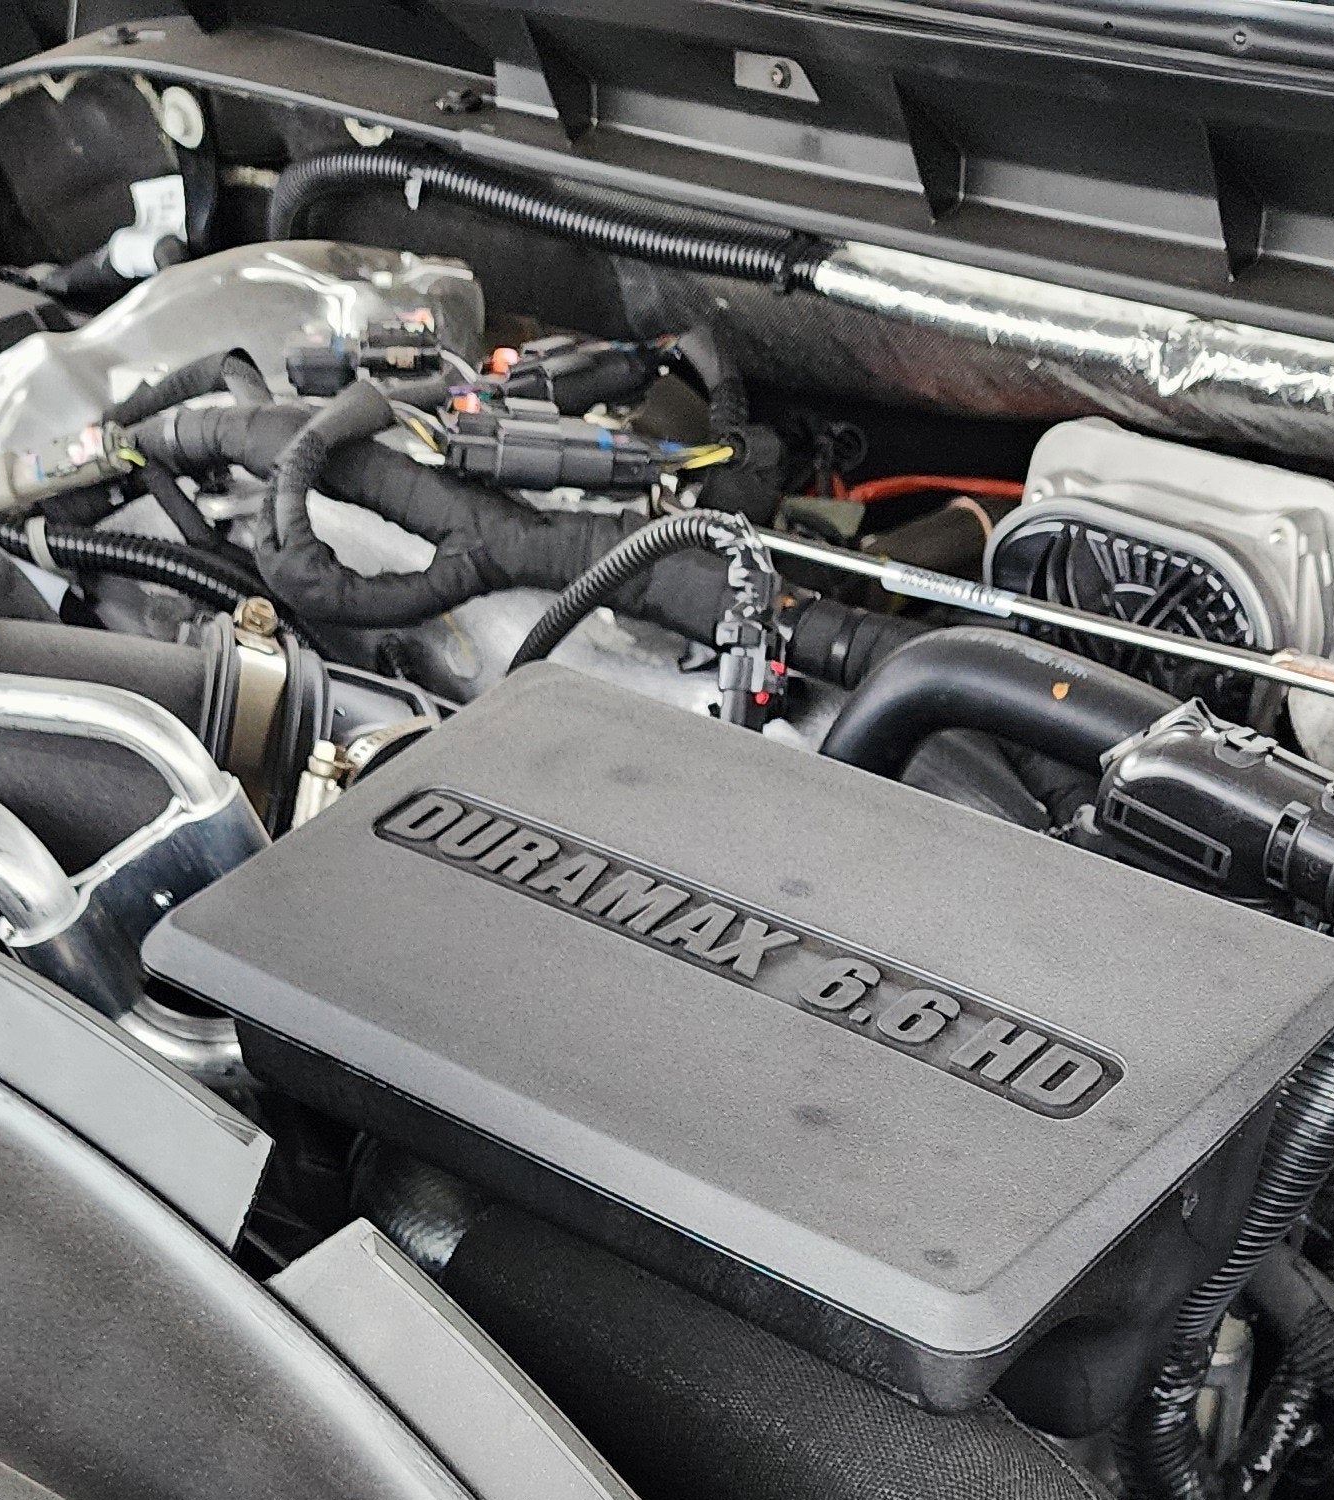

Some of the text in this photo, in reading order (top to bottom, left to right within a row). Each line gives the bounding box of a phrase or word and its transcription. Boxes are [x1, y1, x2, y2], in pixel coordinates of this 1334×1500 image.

[382, 794, 1104, 1106] DURAMAX 6.6 HD
